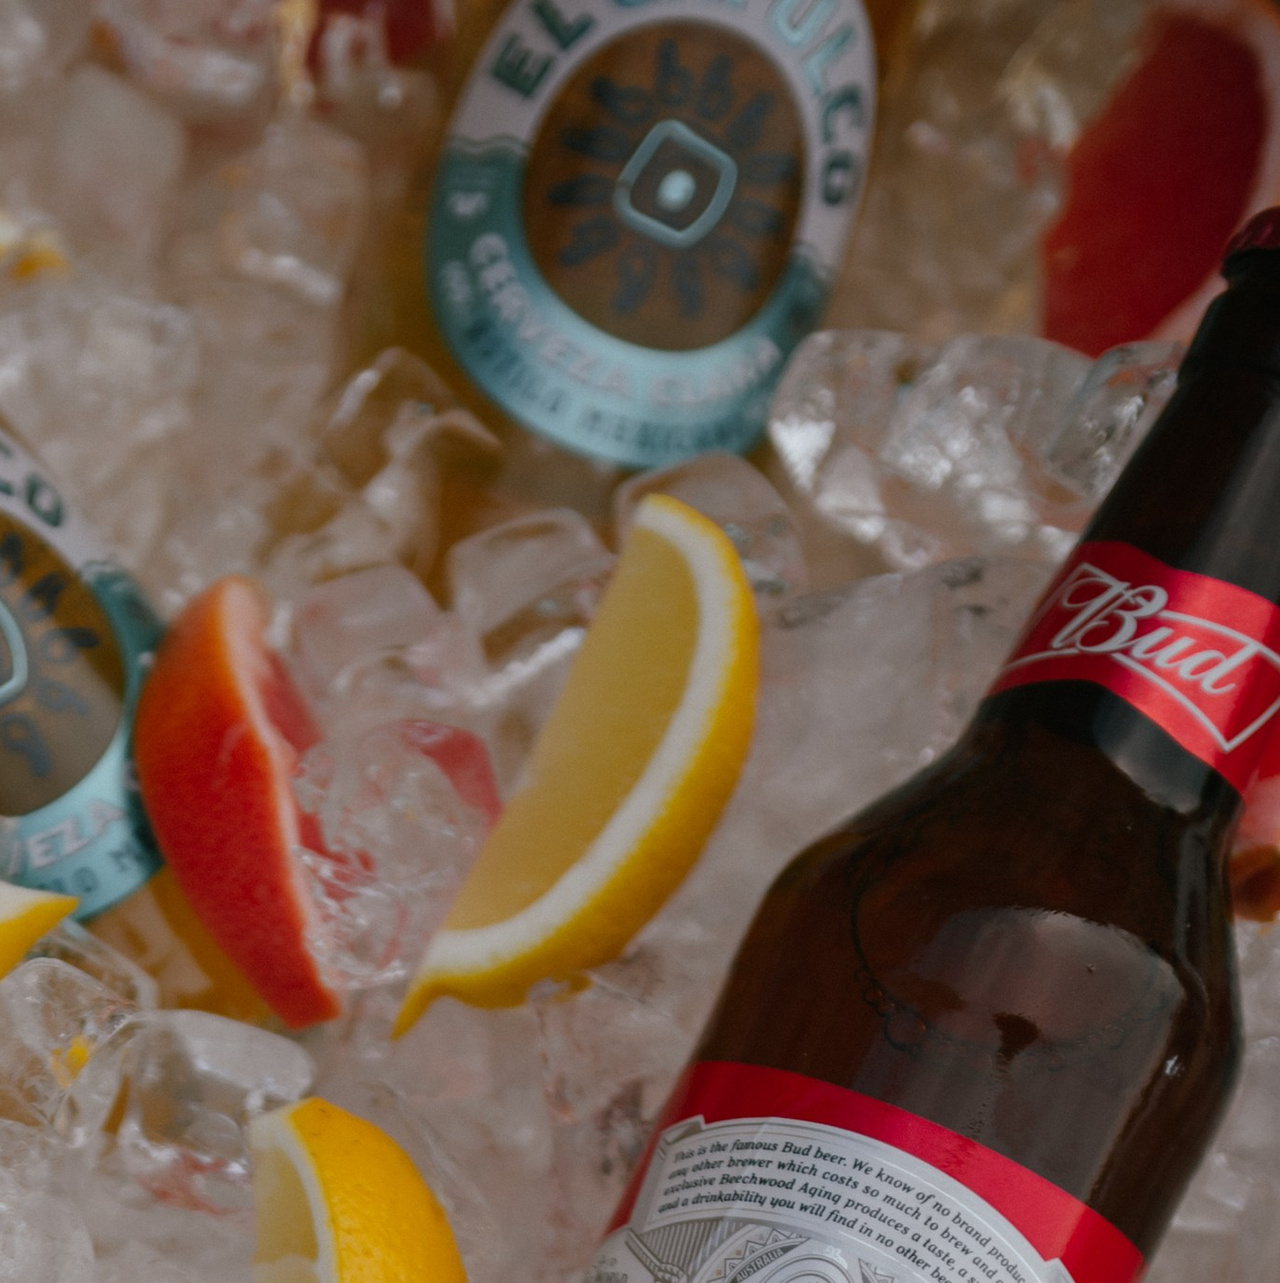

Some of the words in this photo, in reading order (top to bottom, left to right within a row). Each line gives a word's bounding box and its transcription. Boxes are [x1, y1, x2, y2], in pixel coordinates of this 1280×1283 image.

[491, 0, 598, 100] EL
[1050, 576, 1260, 695] Bud
[663, 1175, 716, 1196] exclusive
[720, 1173, 796, 1190] Beechwood
[798, 1182, 842, 1204] Aging
[843, 1198, 910, 1236] produces
[911, 1232, 922, 1243] a
[922, 1238, 957, 1271] taste,
[958, 1267, 969, 1278] a
[674, 1147, 694, 1163] This
[697, 1145, 707, 1156] is
[709, 1141, 728, 1153] the
[730, 1139, 779, 1154] famous
[781, 1141, 811, 1157] Bud
[814, 1147, 847, 1168] beer.
[852, 1158, 873, 1175] We
[875, 1167, 915, 1194] know
[916, 1191, 936, 1205] of
[932, 1201, 951, 1217] no
[952, 1213, 992, 1249] brand
[692, 1158, 723, 1173] other
[727, 1156, 774, 1169] brewer
[777, 1160, 818, 1177] which
[822, 1171, 860, 1190] costs
[862, 1184, 880, 1198] so
[882, 1194, 922, 1221] much
[923, 1216, 939, 1232] to
[940, 1227, 973, 1256] brew
[972, 1255, 998, 1280] and
[692, 1190, 767, 1207] drinkability
[769, 1197, 795, 1210] you
[799, 1204, 825, 1218] will
[825, 1209, 859, 1230] find
[858, 1222, 874, 1237] in
[875, 1233, 894, 1248] no
[895, 1245, 931, 1270] other
[736, 1248, 784, 1283] AUSTRALIA
